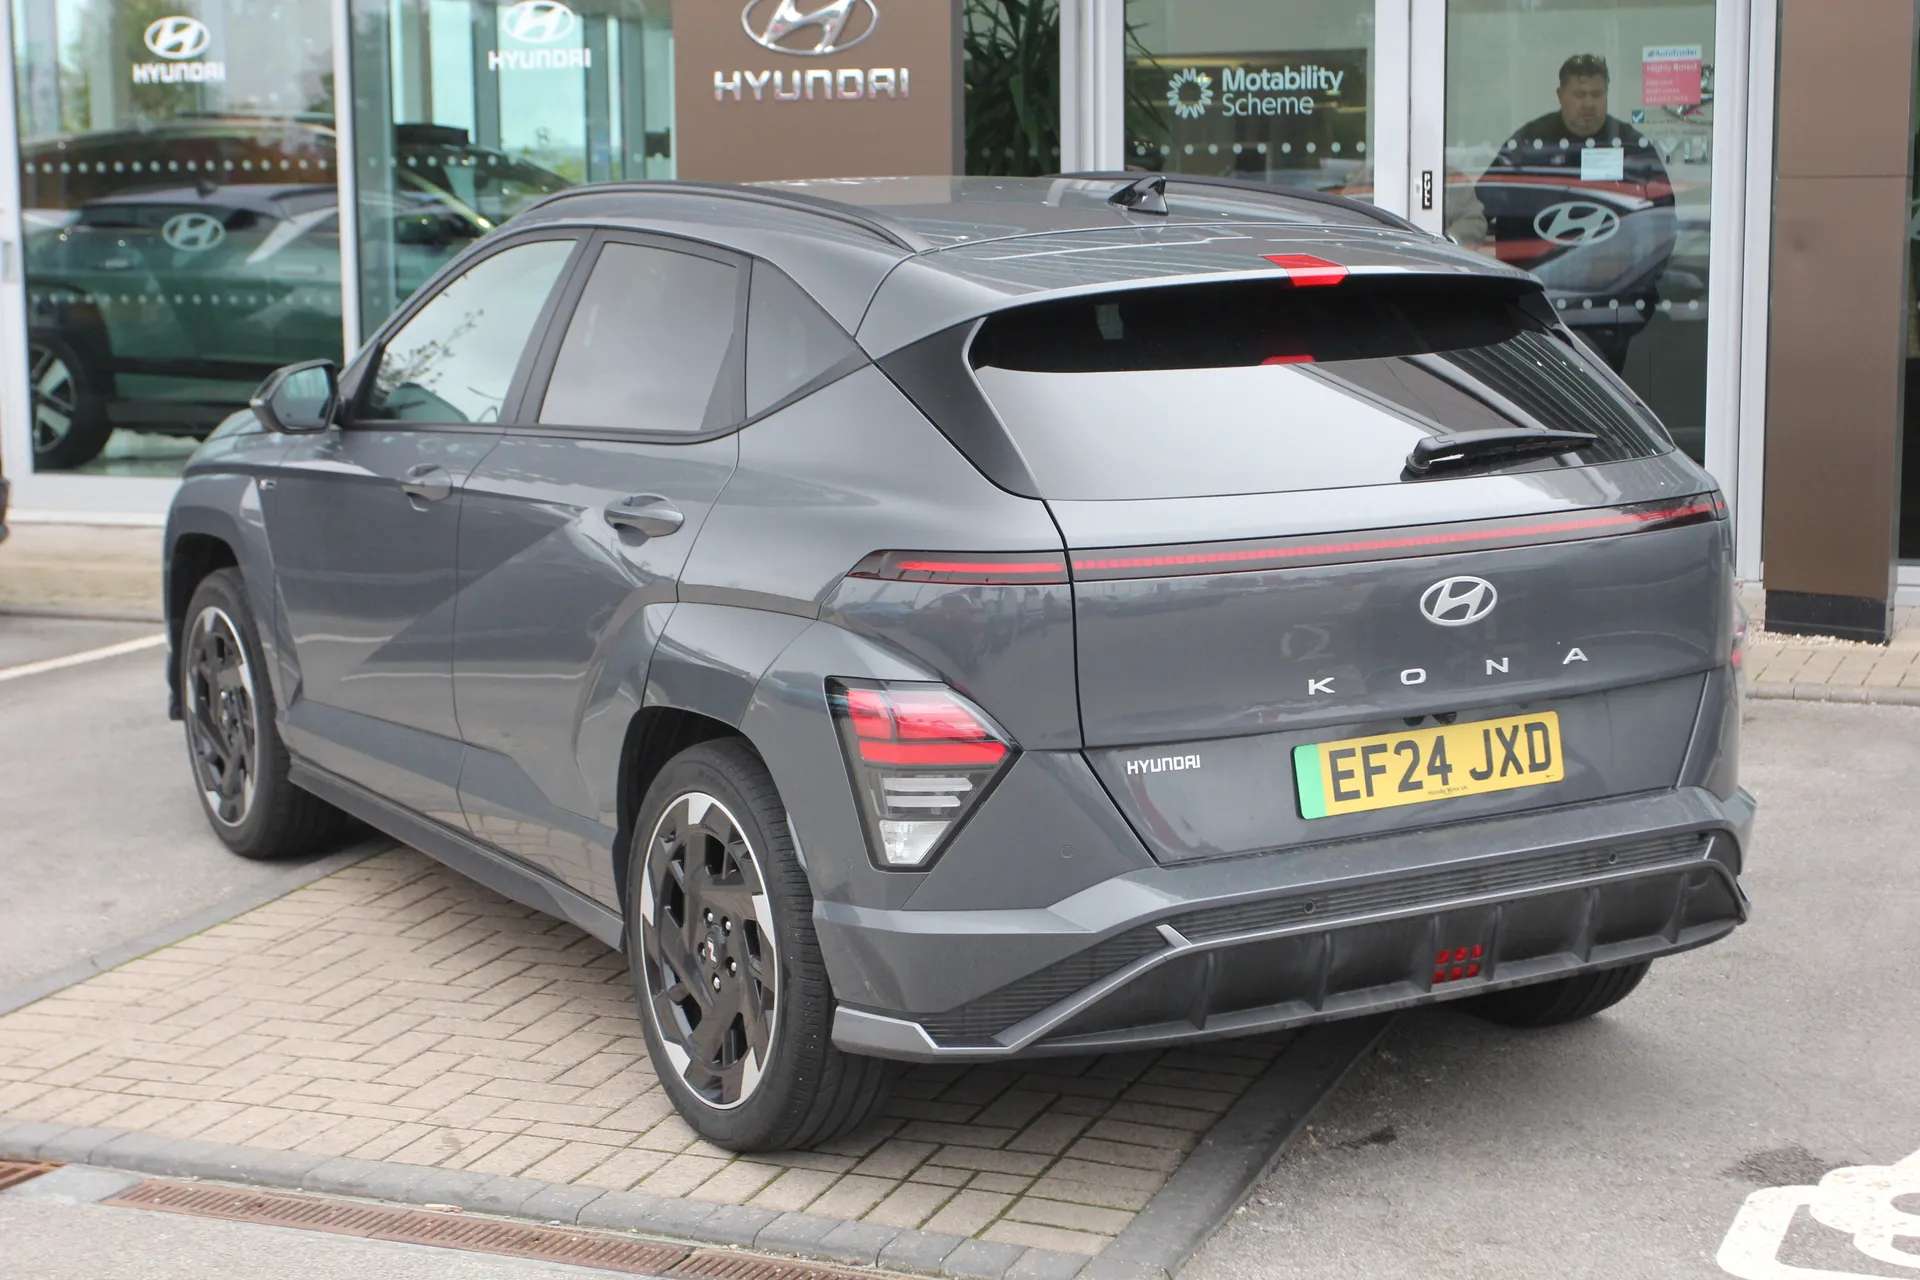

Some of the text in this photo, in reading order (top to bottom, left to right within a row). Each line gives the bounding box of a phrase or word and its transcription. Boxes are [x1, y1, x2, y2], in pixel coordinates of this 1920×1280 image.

[132, 62, 226, 84] HYUNDAI
[487, 48, 592, 71] HYUNDAI
[713, 67, 909, 101] HYUNDAI
[1222, 65, 1344, 92] Motability
[1222, 92, 1314, 117] Scheme
[1423, 172, 1431, 207] PULL
[1308, 647, 1588, 696] KONA
[1126, 754, 1201, 775] HYUNDAI
[1328, 721, 1553, 803] EF24 JXD
